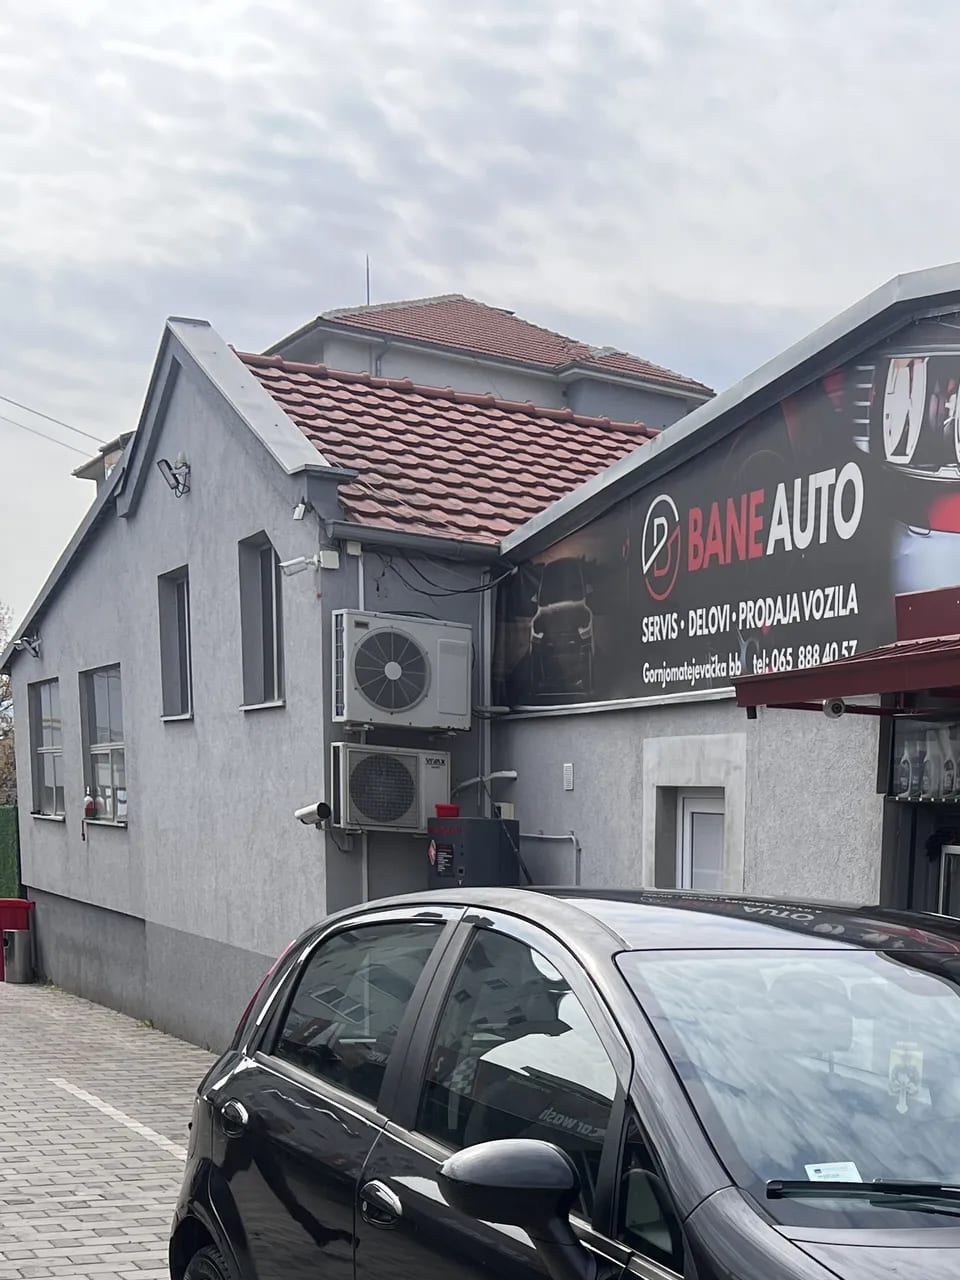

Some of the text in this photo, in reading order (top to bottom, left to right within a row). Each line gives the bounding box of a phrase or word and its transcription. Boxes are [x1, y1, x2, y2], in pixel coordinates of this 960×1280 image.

[687, 462, 864, 572] BANE AUTO
[641, 583, 859, 643] SERVIS DELOVI PRODAJA VOZILA
[642, 639, 858, 688] Gornjomatejevačka bb tel: 065 888 40 57
